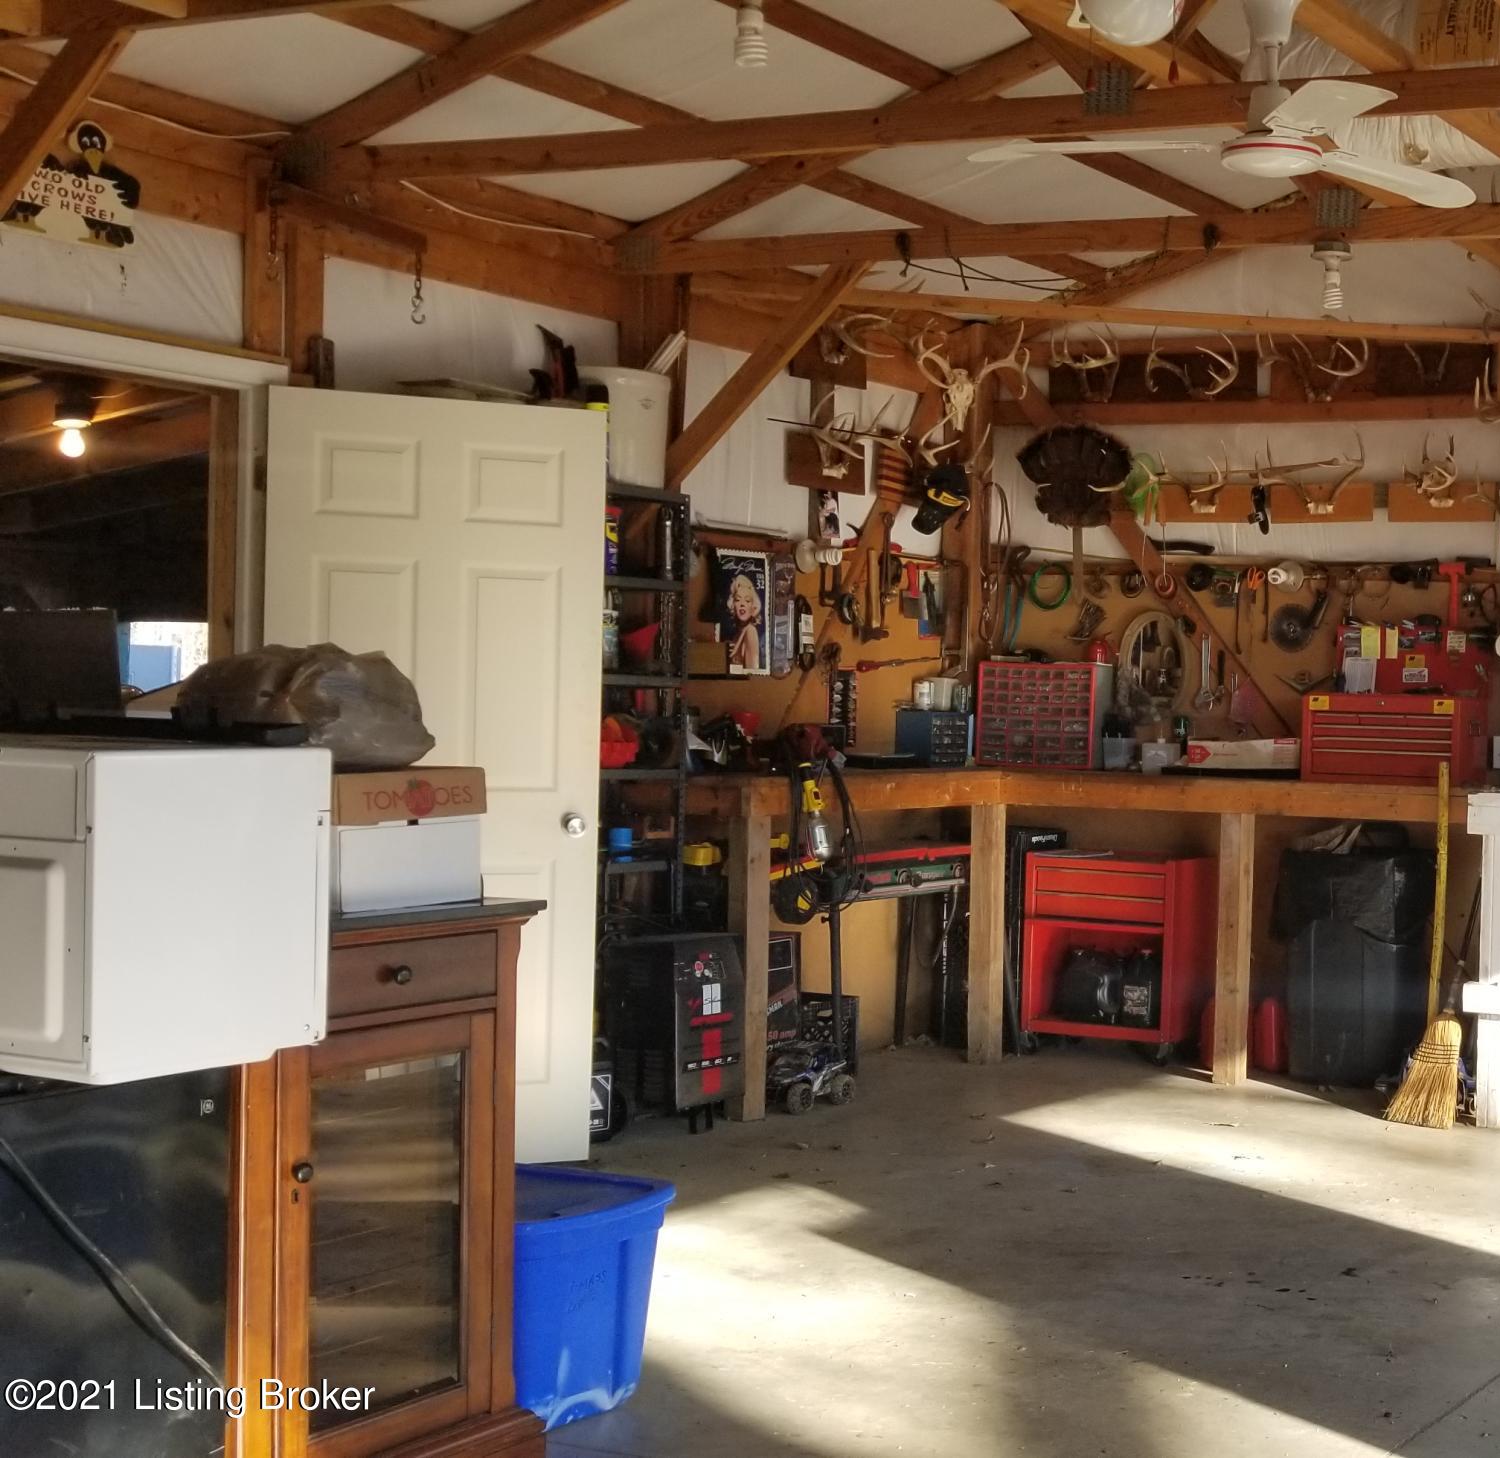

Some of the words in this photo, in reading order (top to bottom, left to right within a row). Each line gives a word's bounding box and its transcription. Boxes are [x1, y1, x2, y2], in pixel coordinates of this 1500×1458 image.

[31, 180, 98, 206] CROWS
[34, 169, 63, 184] WO
[72, 179, 105, 194] OLD
[20, 190, 50, 207] IVE
[60, 201, 115, 222] HERE!
[363, 785, 473, 811] TOMOES
